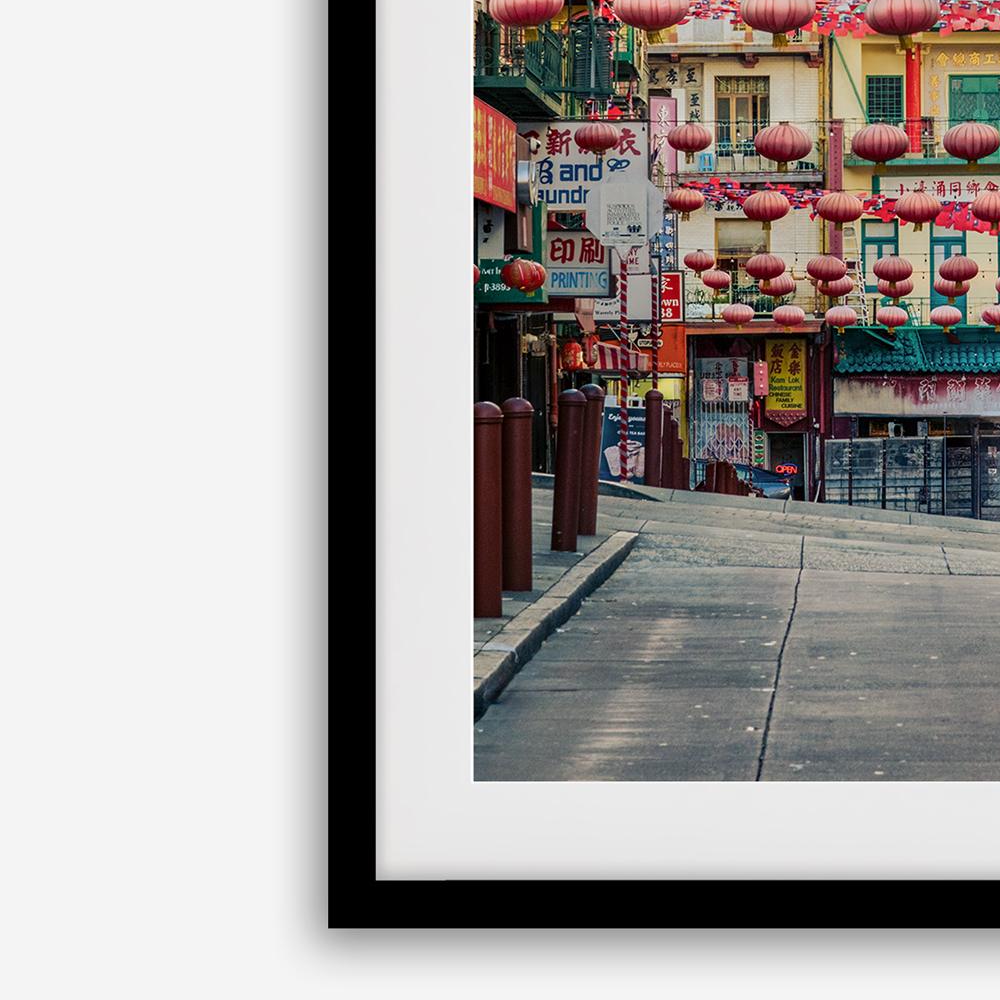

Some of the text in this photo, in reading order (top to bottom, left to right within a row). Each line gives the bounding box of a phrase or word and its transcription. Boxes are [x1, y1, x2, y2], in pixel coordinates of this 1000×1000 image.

[560, 157, 604, 182] and
[550, 237, 605, 265] 印刷
[551, 271, 607, 289] PRINTING
[776, 465, 797, 474] OPEN
